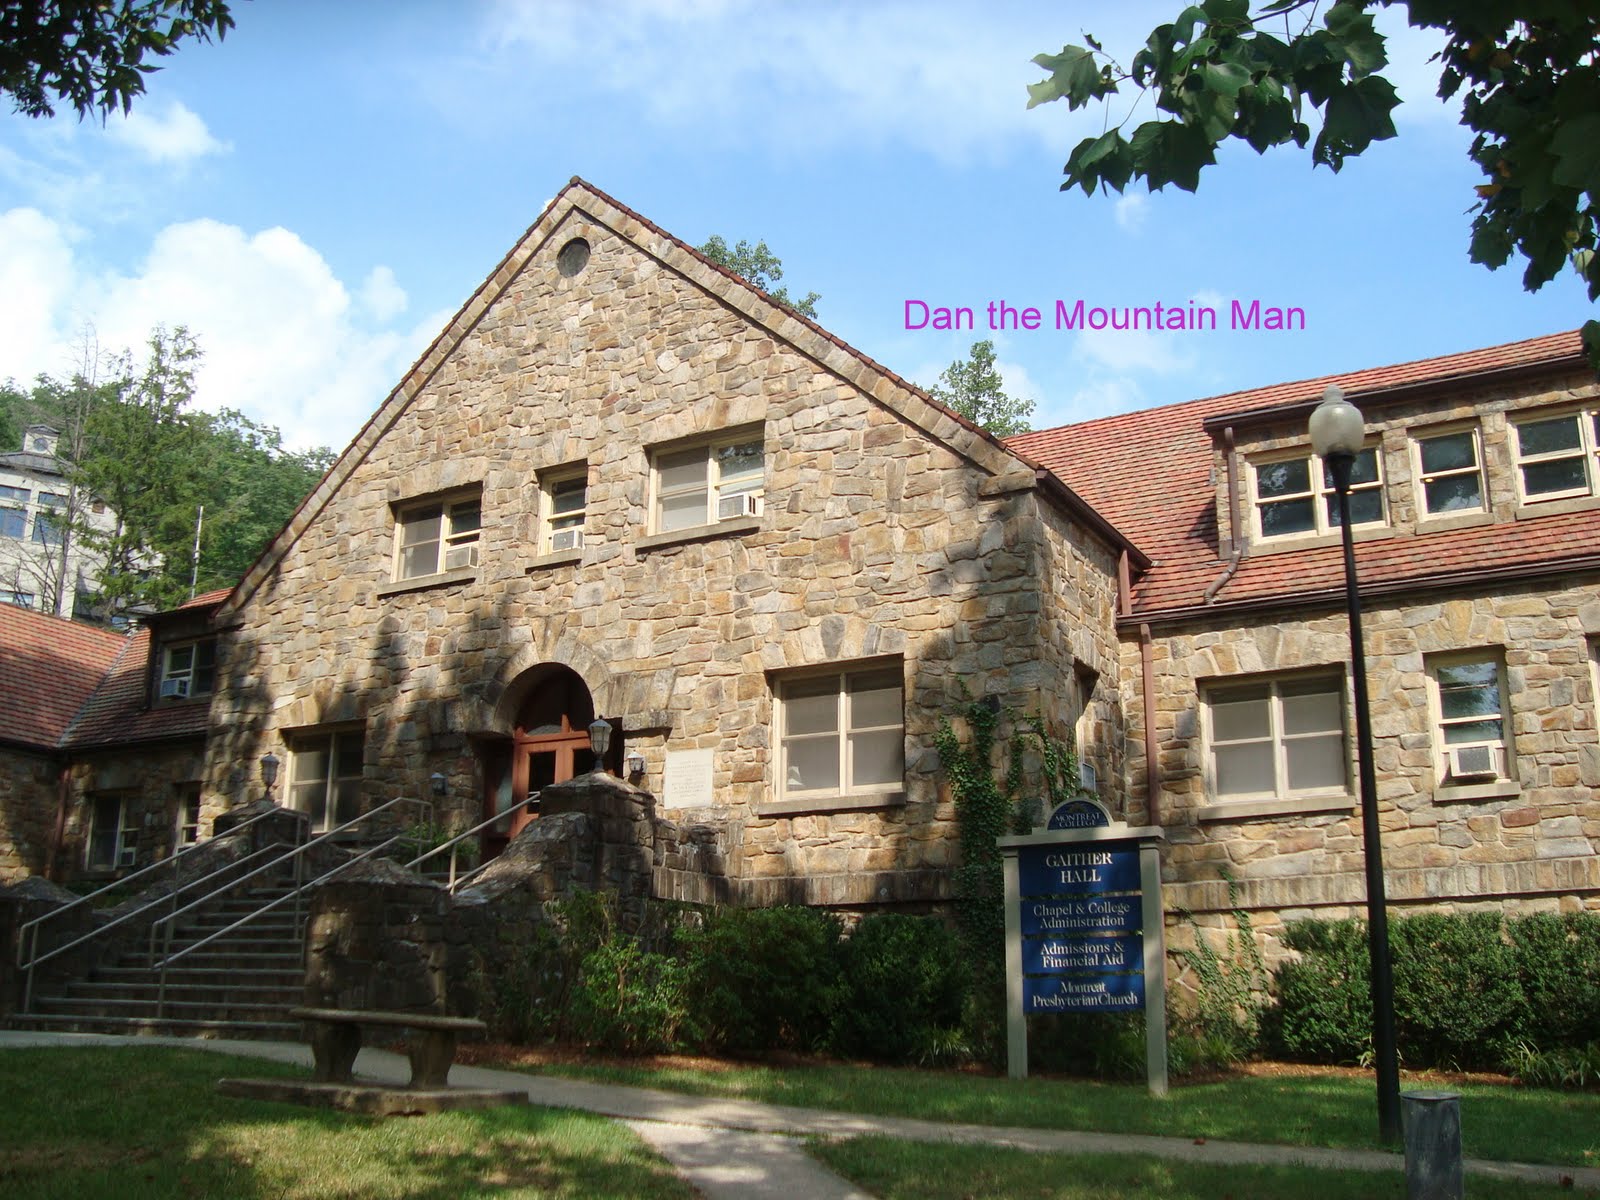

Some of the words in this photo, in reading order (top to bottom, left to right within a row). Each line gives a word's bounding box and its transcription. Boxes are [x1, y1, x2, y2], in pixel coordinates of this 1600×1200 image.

[1046, 852, 1113, 867] GAITHER
[1061, 870, 1101, 884] HALL
[1033, 904, 1072, 917] Chapel
[1076, 904, 1084, 914] &
[1088, 902, 1130, 916] College
[1040, 916, 1125, 929] Administration
[1041, 943, 1109, 955] Admissions
[1115, 941, 1124, 952] &
[1042, 954, 1099, 968] Financial
[1102, 953, 1124, 965] Aid
[1061, 982, 1106, 993] Montreat
[1033, 994, 1098, 1009] Presbyterian
[1098, 992, 1138, 1005] Church
